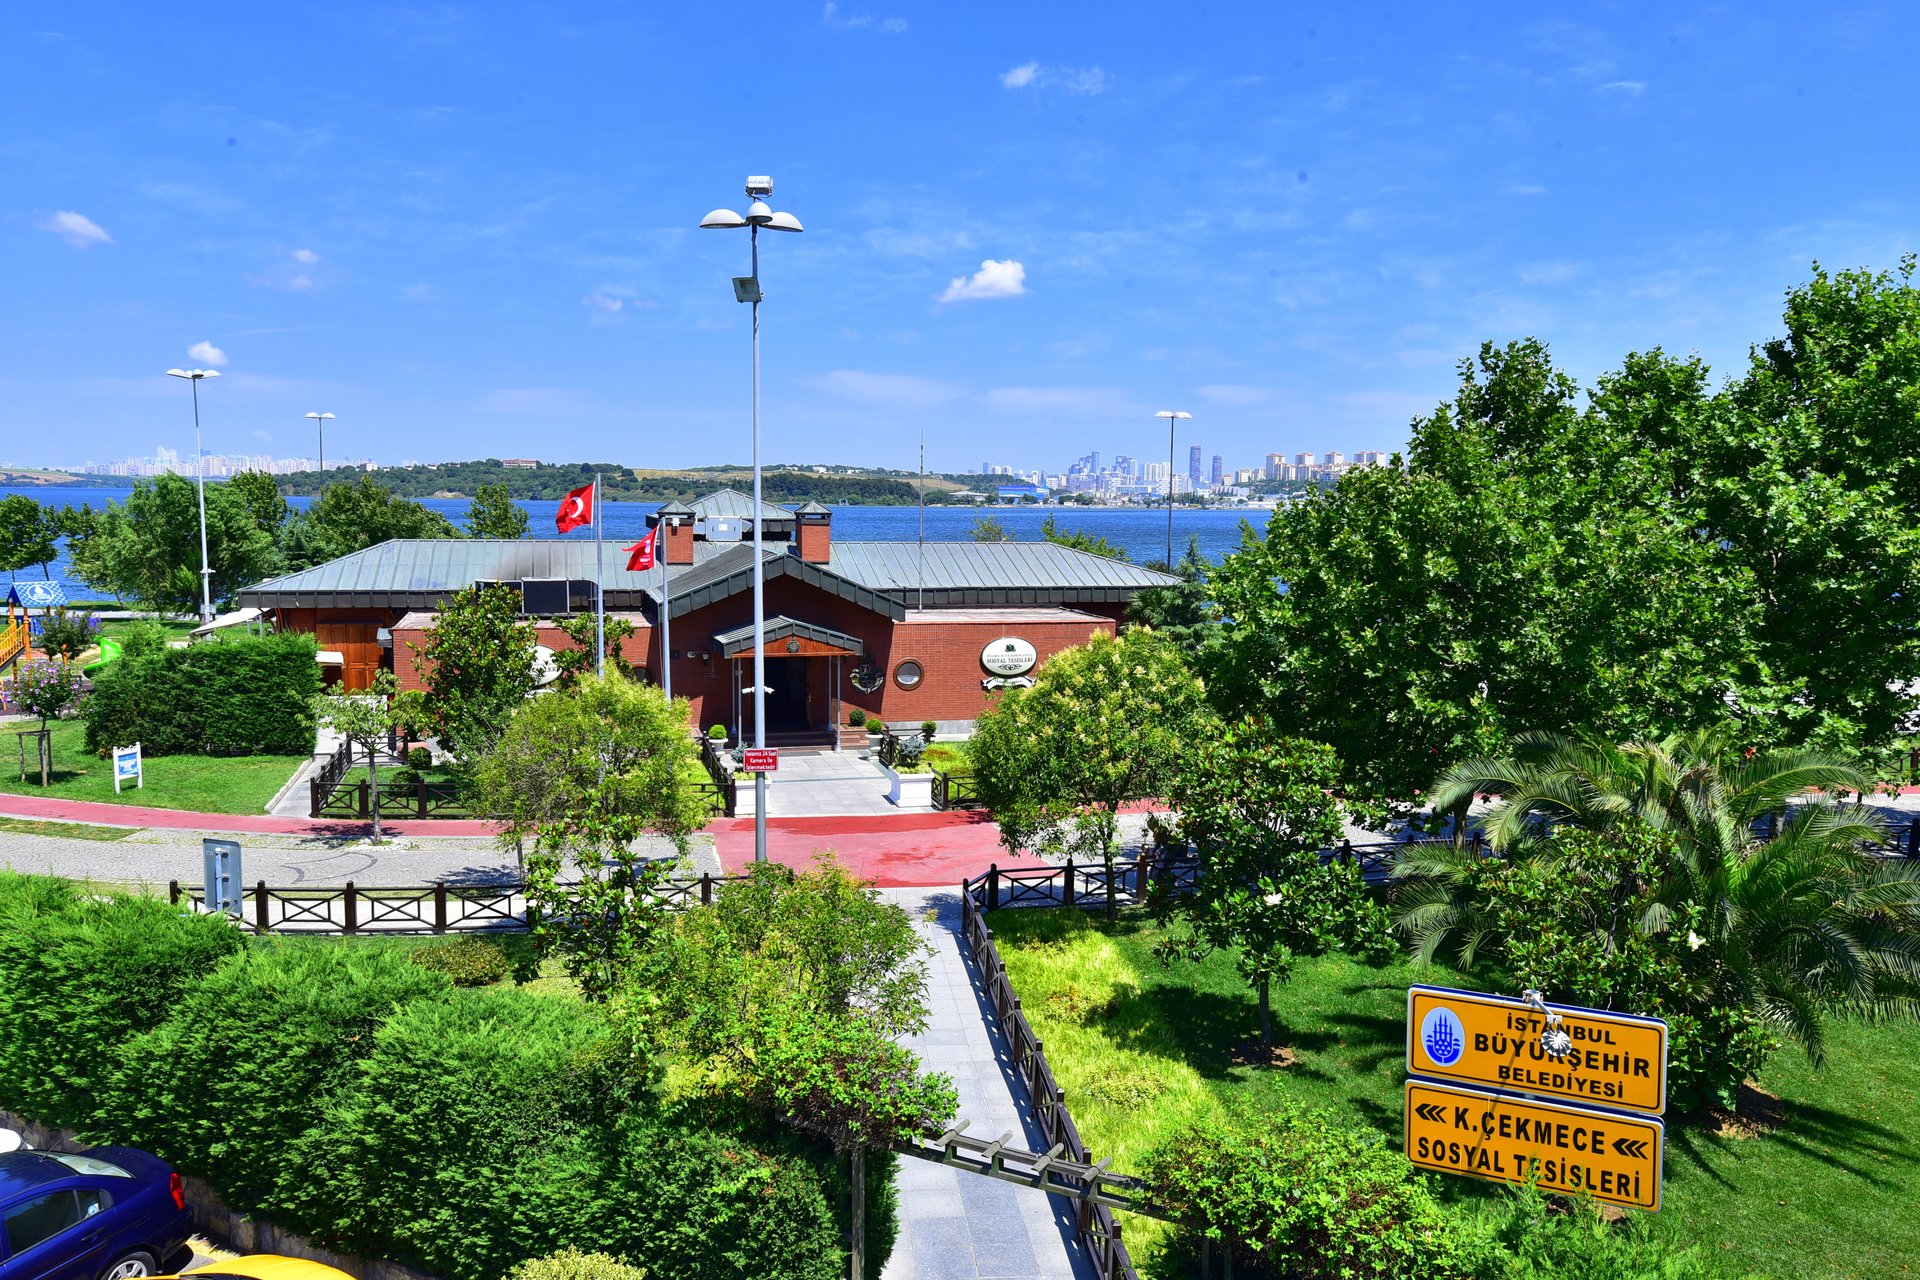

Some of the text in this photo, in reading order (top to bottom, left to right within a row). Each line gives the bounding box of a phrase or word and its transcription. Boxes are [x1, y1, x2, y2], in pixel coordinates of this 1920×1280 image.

[1498, 1065, 1624, 1099] BELEDİYESİ
[1454, 1106, 1606, 1155] K.ÇEKMECE
[1417, 1136, 1505, 1174] SOSYAL
